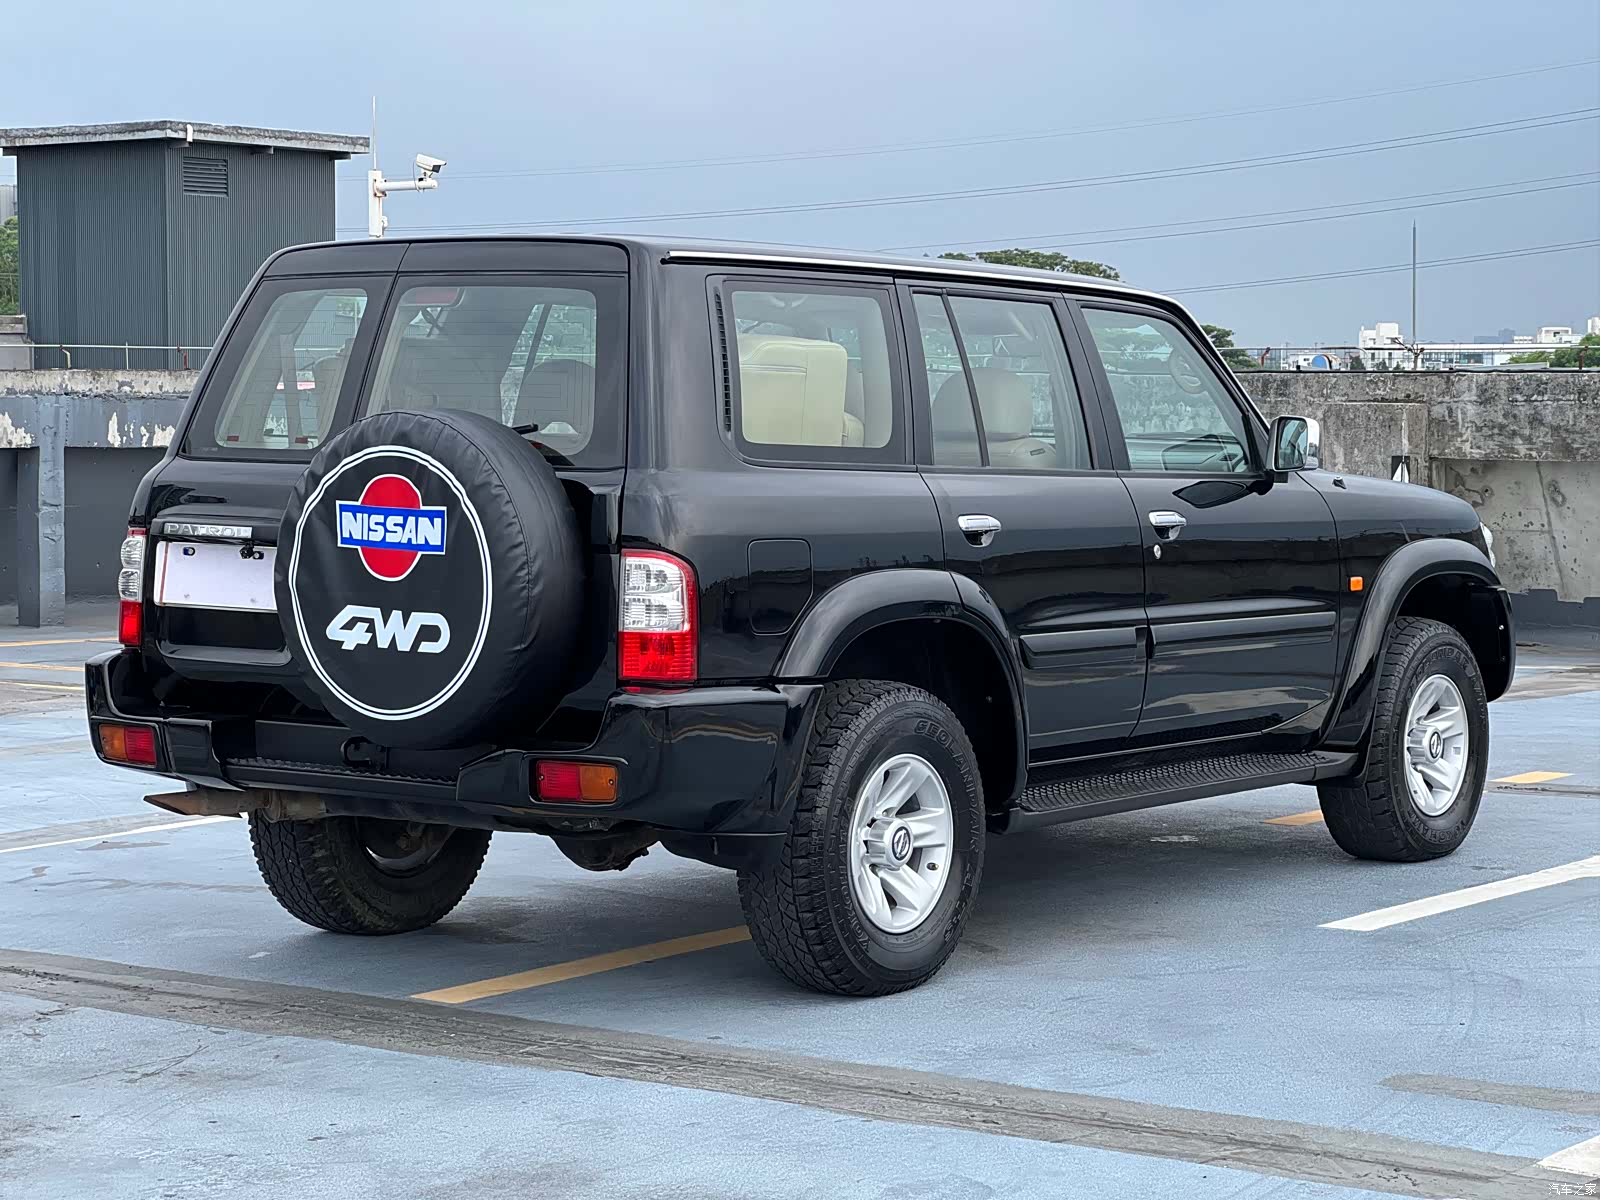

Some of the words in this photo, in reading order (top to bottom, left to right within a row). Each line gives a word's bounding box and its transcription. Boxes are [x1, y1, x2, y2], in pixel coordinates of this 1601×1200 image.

[164, 522, 252, 538] PATROL
[341, 511, 442, 545] NISSAN
[326, 604, 450, 653] 4WD
